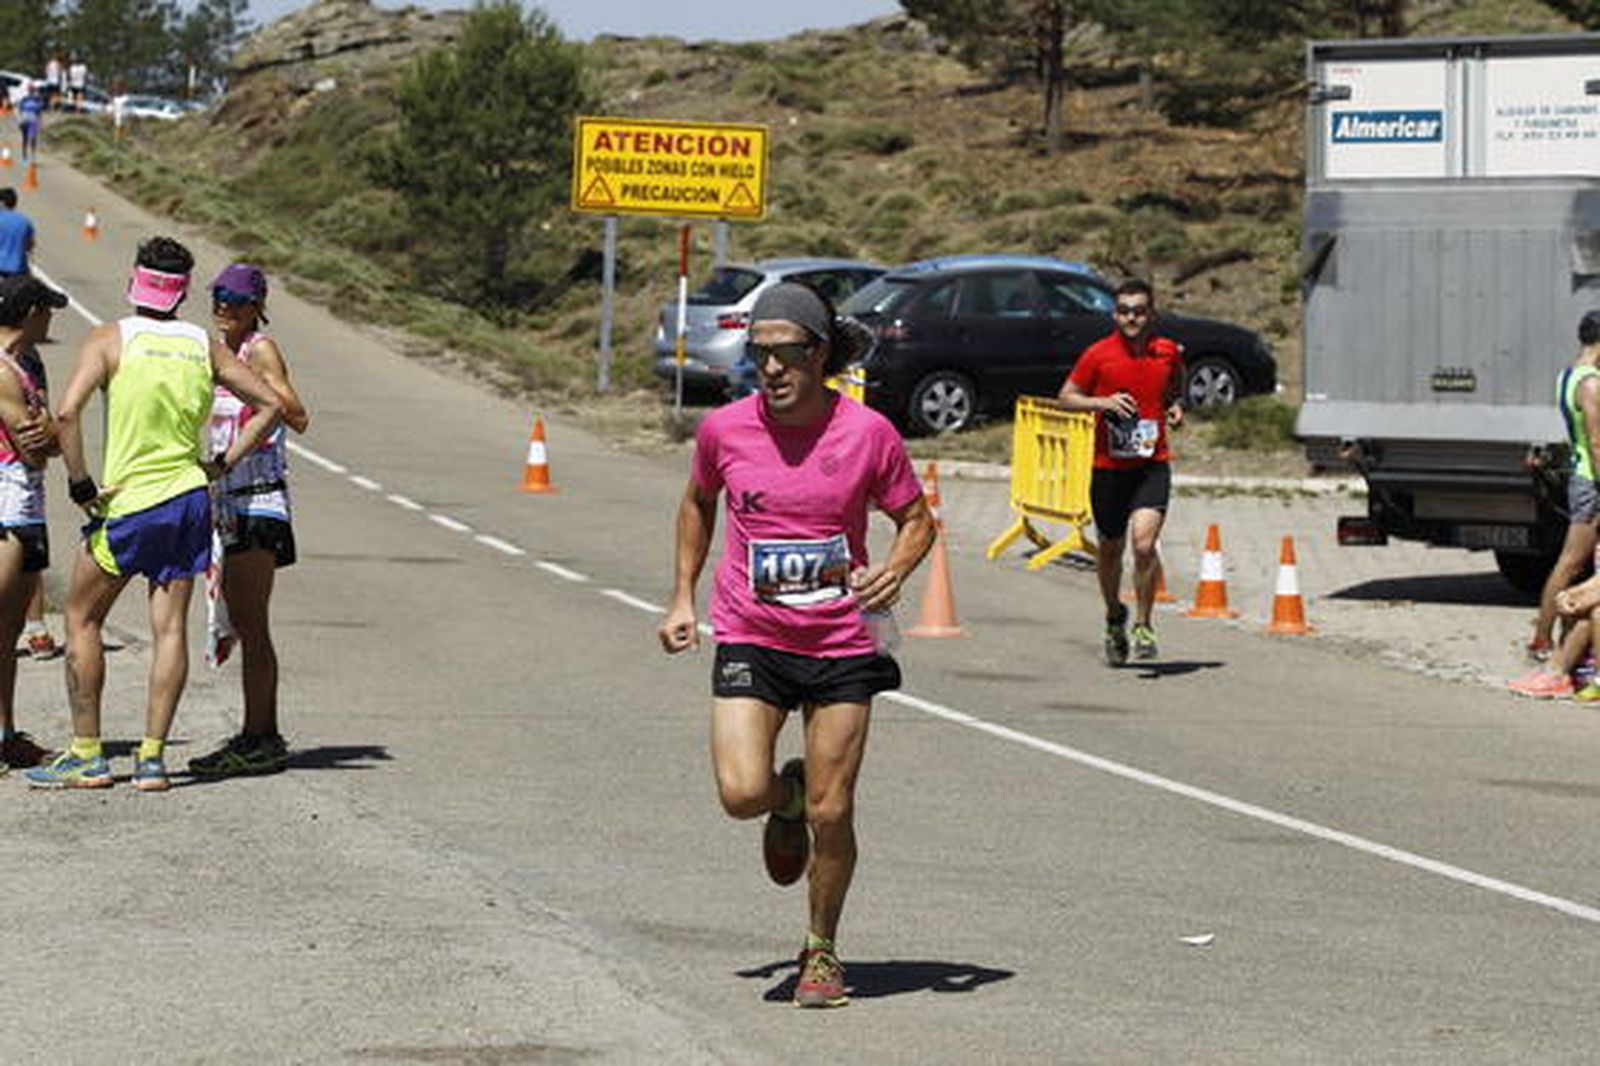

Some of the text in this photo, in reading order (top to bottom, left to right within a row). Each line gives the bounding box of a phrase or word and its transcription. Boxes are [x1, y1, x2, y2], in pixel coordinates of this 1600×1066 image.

[1336, 115, 1440, 138] Almericar
[593, 131, 751, 157] ATENCION
[586, 156, 755, 179] POSIBLES ZONAS CON HIELO
[762, 552, 826, 584] 107
